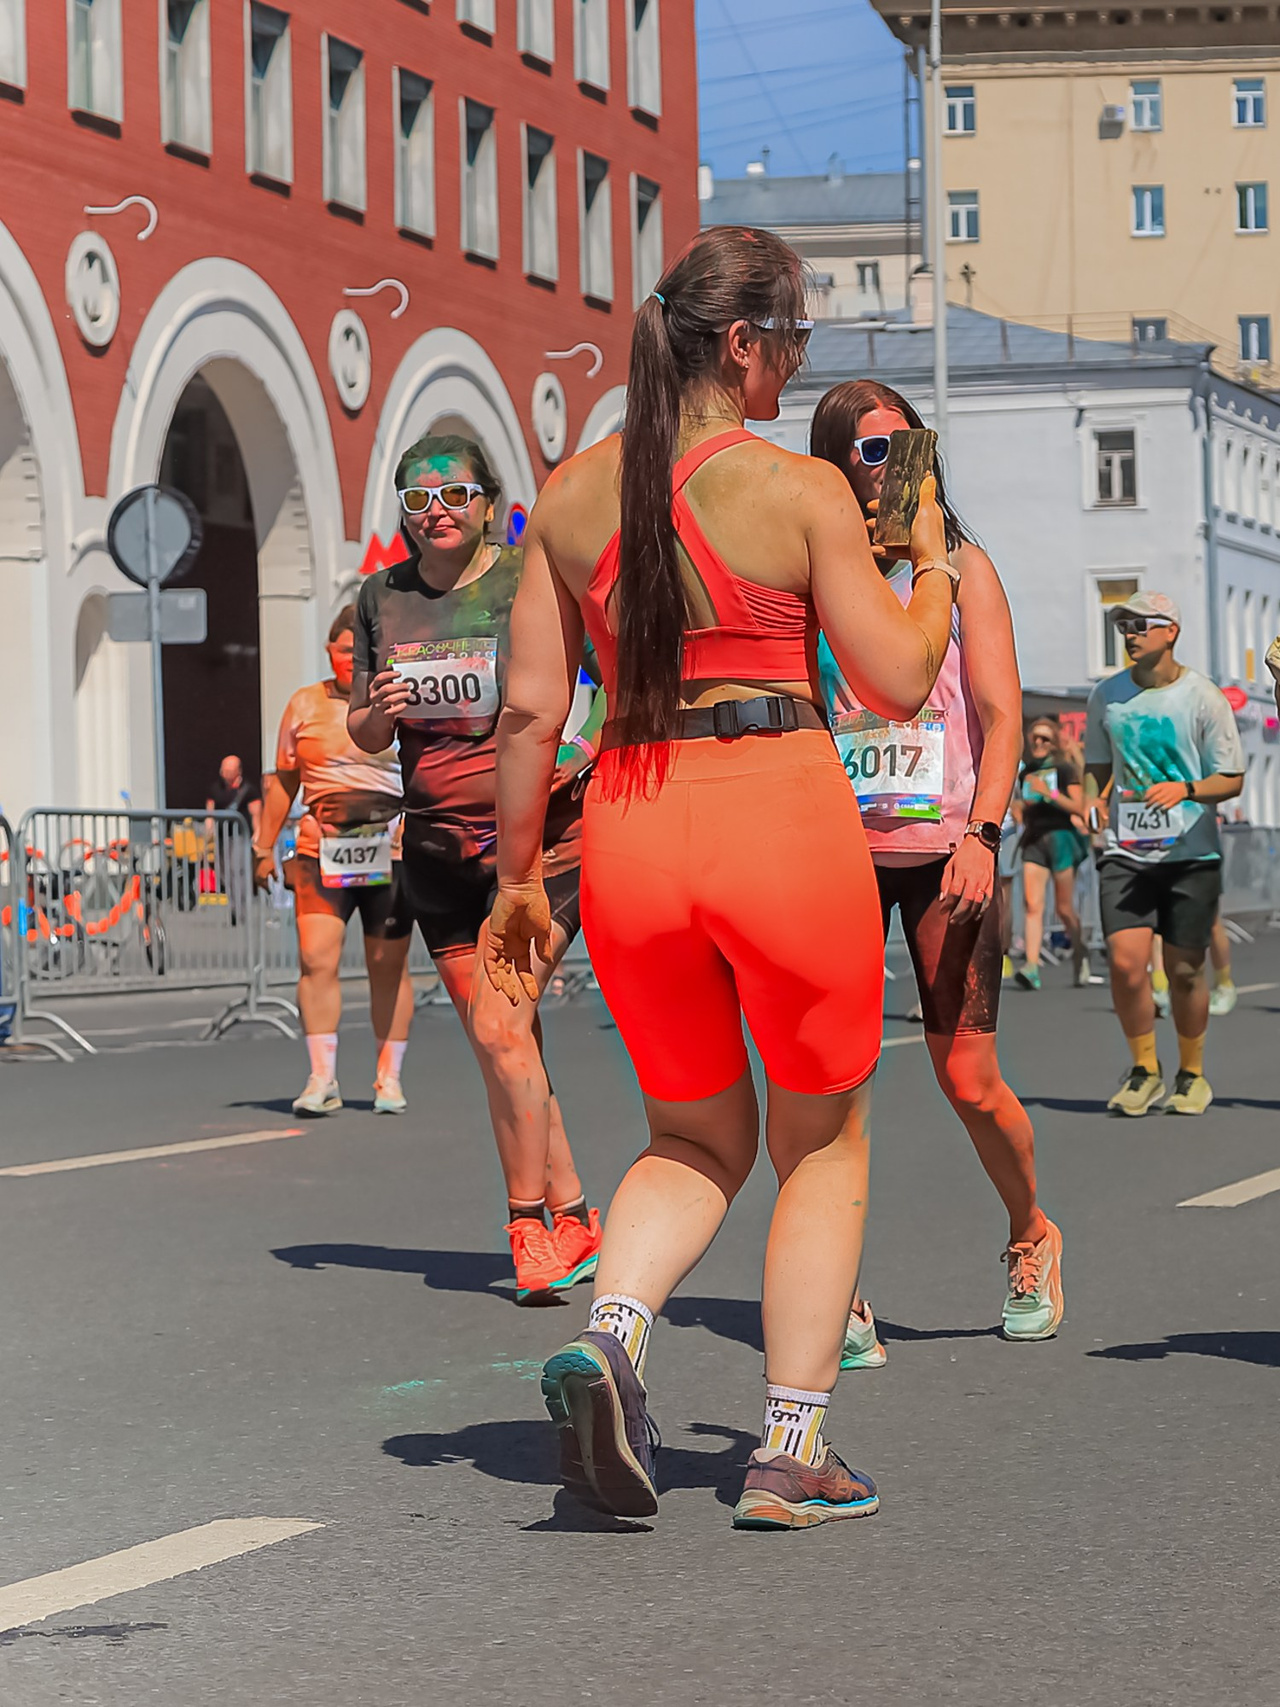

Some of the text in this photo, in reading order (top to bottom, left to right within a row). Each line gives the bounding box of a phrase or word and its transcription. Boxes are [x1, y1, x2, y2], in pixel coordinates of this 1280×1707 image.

[401, 672, 481, 706] 3300
[843, 743, 923, 781] 6017
[1127, 810, 1170, 831] 7431
[332, 846, 377, 864] 4137
